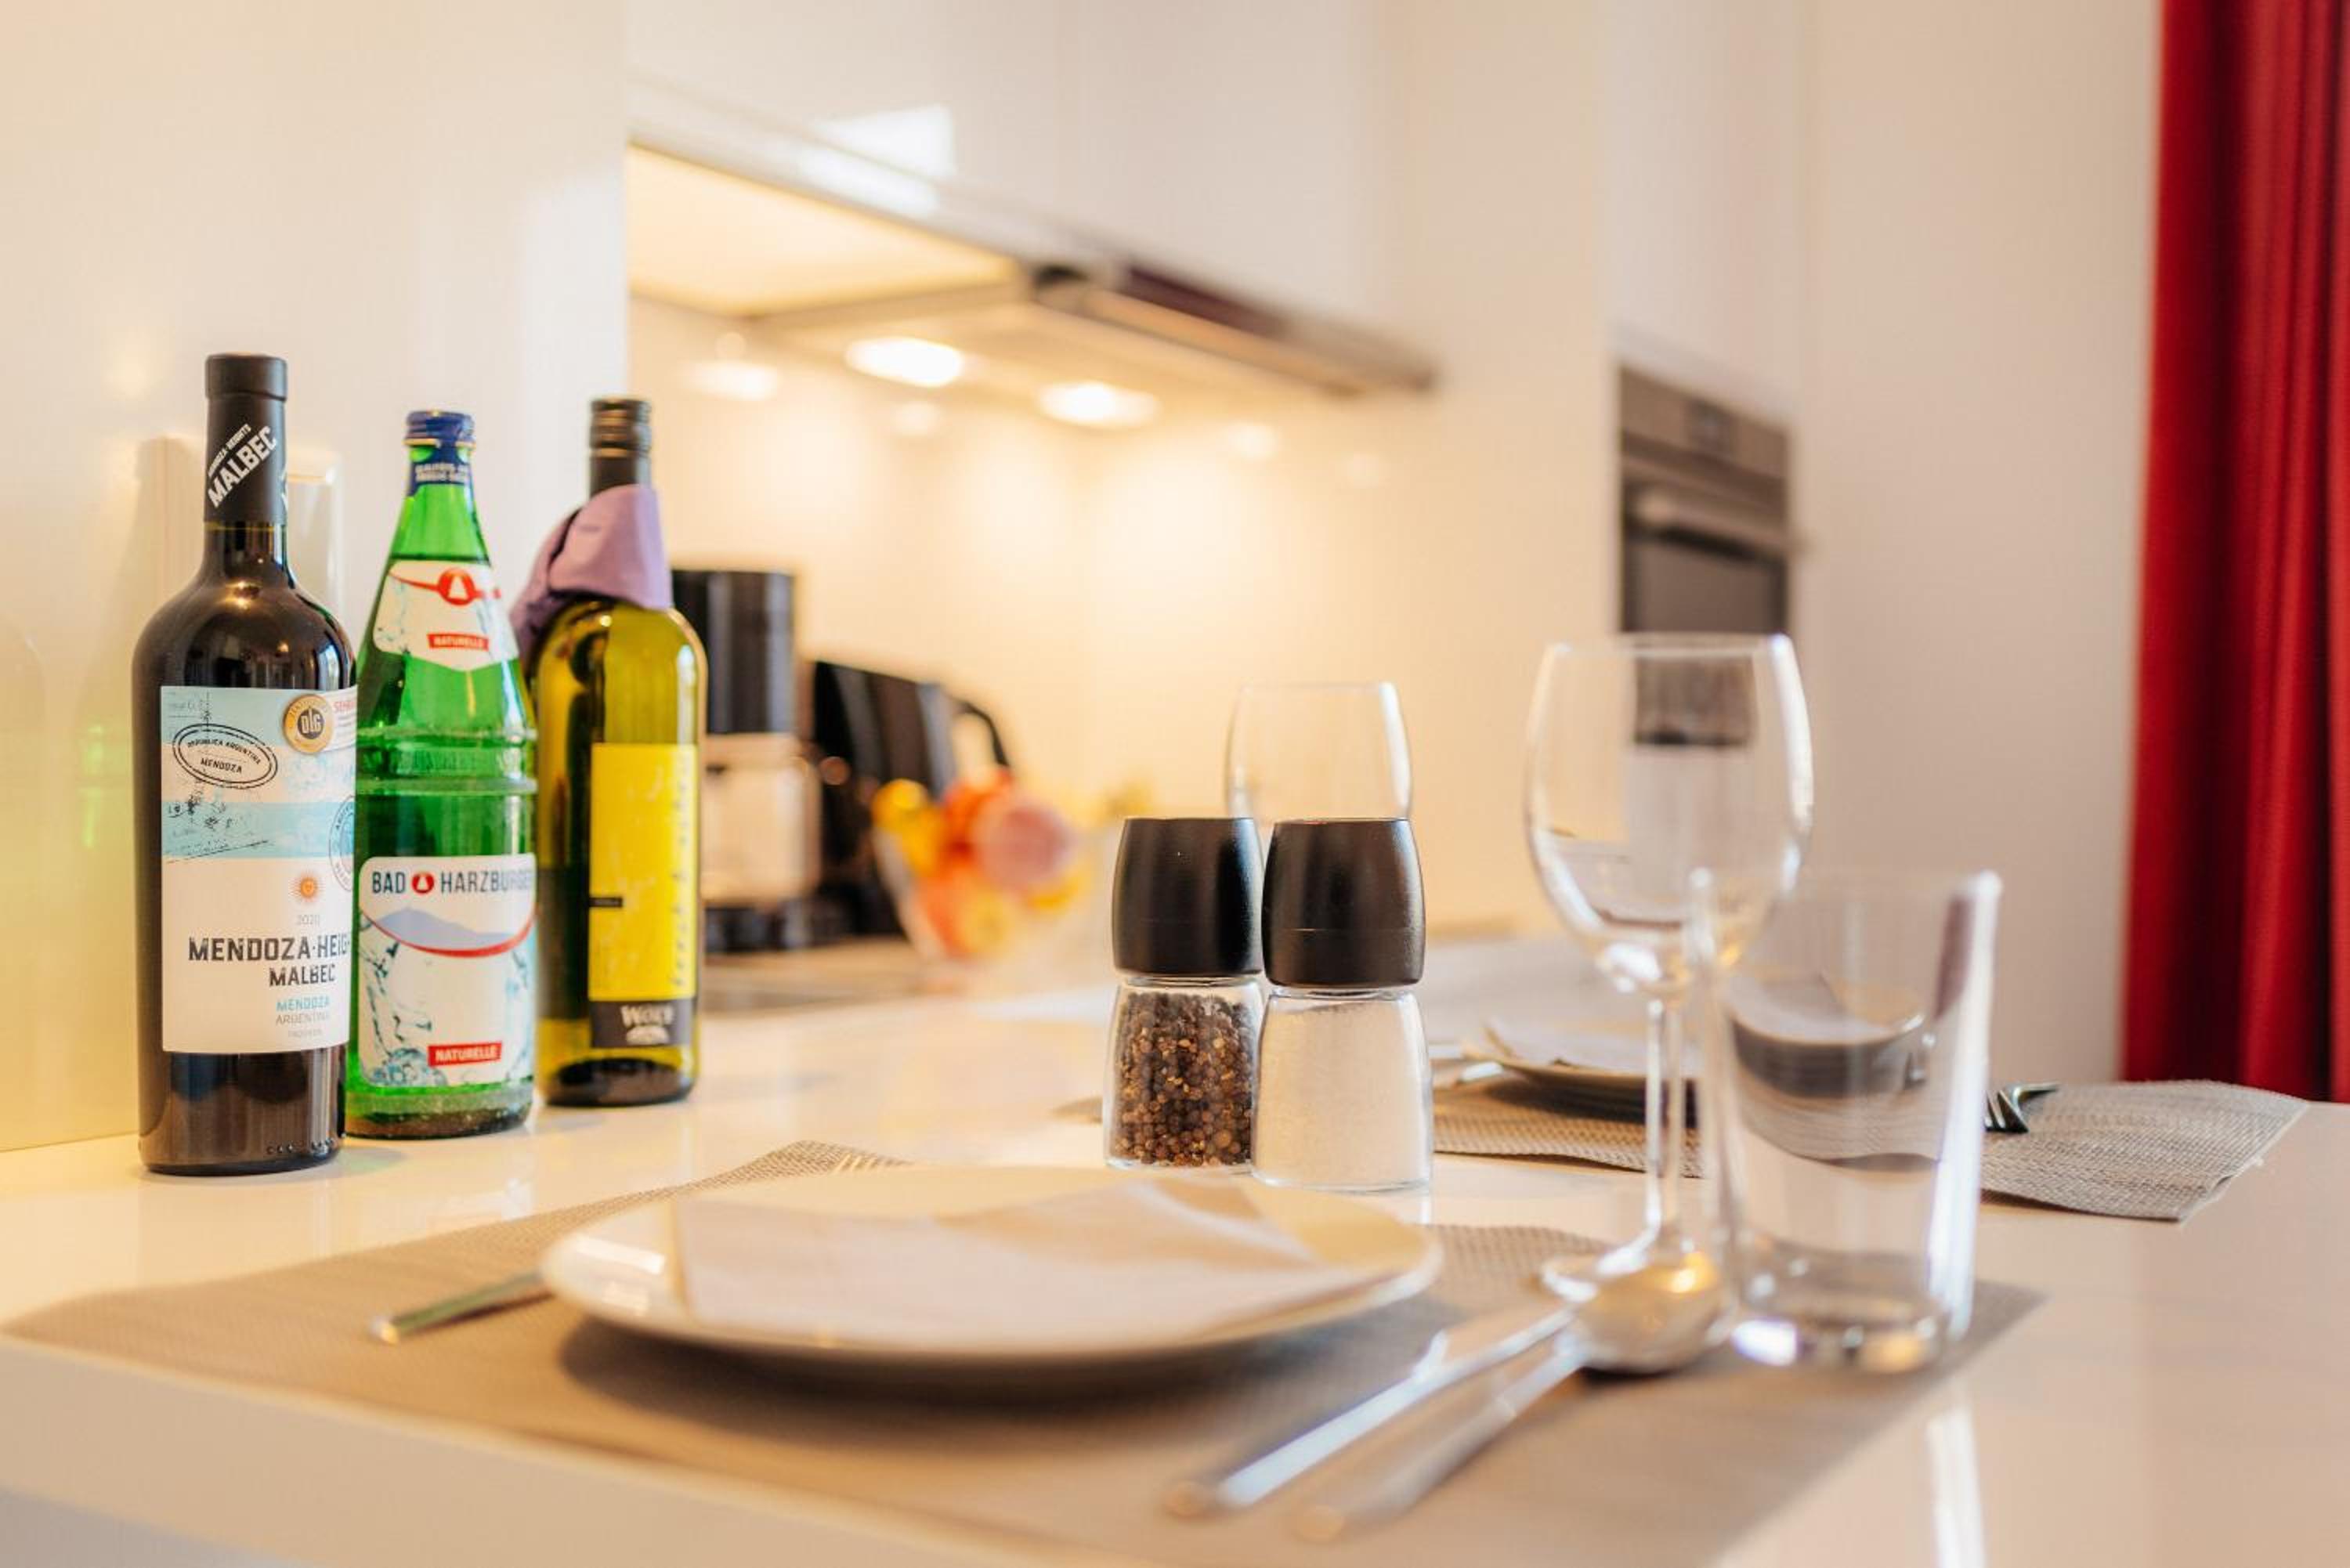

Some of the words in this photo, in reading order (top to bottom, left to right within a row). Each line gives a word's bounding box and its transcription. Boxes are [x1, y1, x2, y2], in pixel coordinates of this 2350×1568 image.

[208, 425, 277, 508] MALBEC
[200, 757, 243, 774] MENDOZA
[372, 871, 406, 894] BAD
[269, 963, 336, 987] MALBEC
[435, 1044, 497, 1062] NATURELLE
